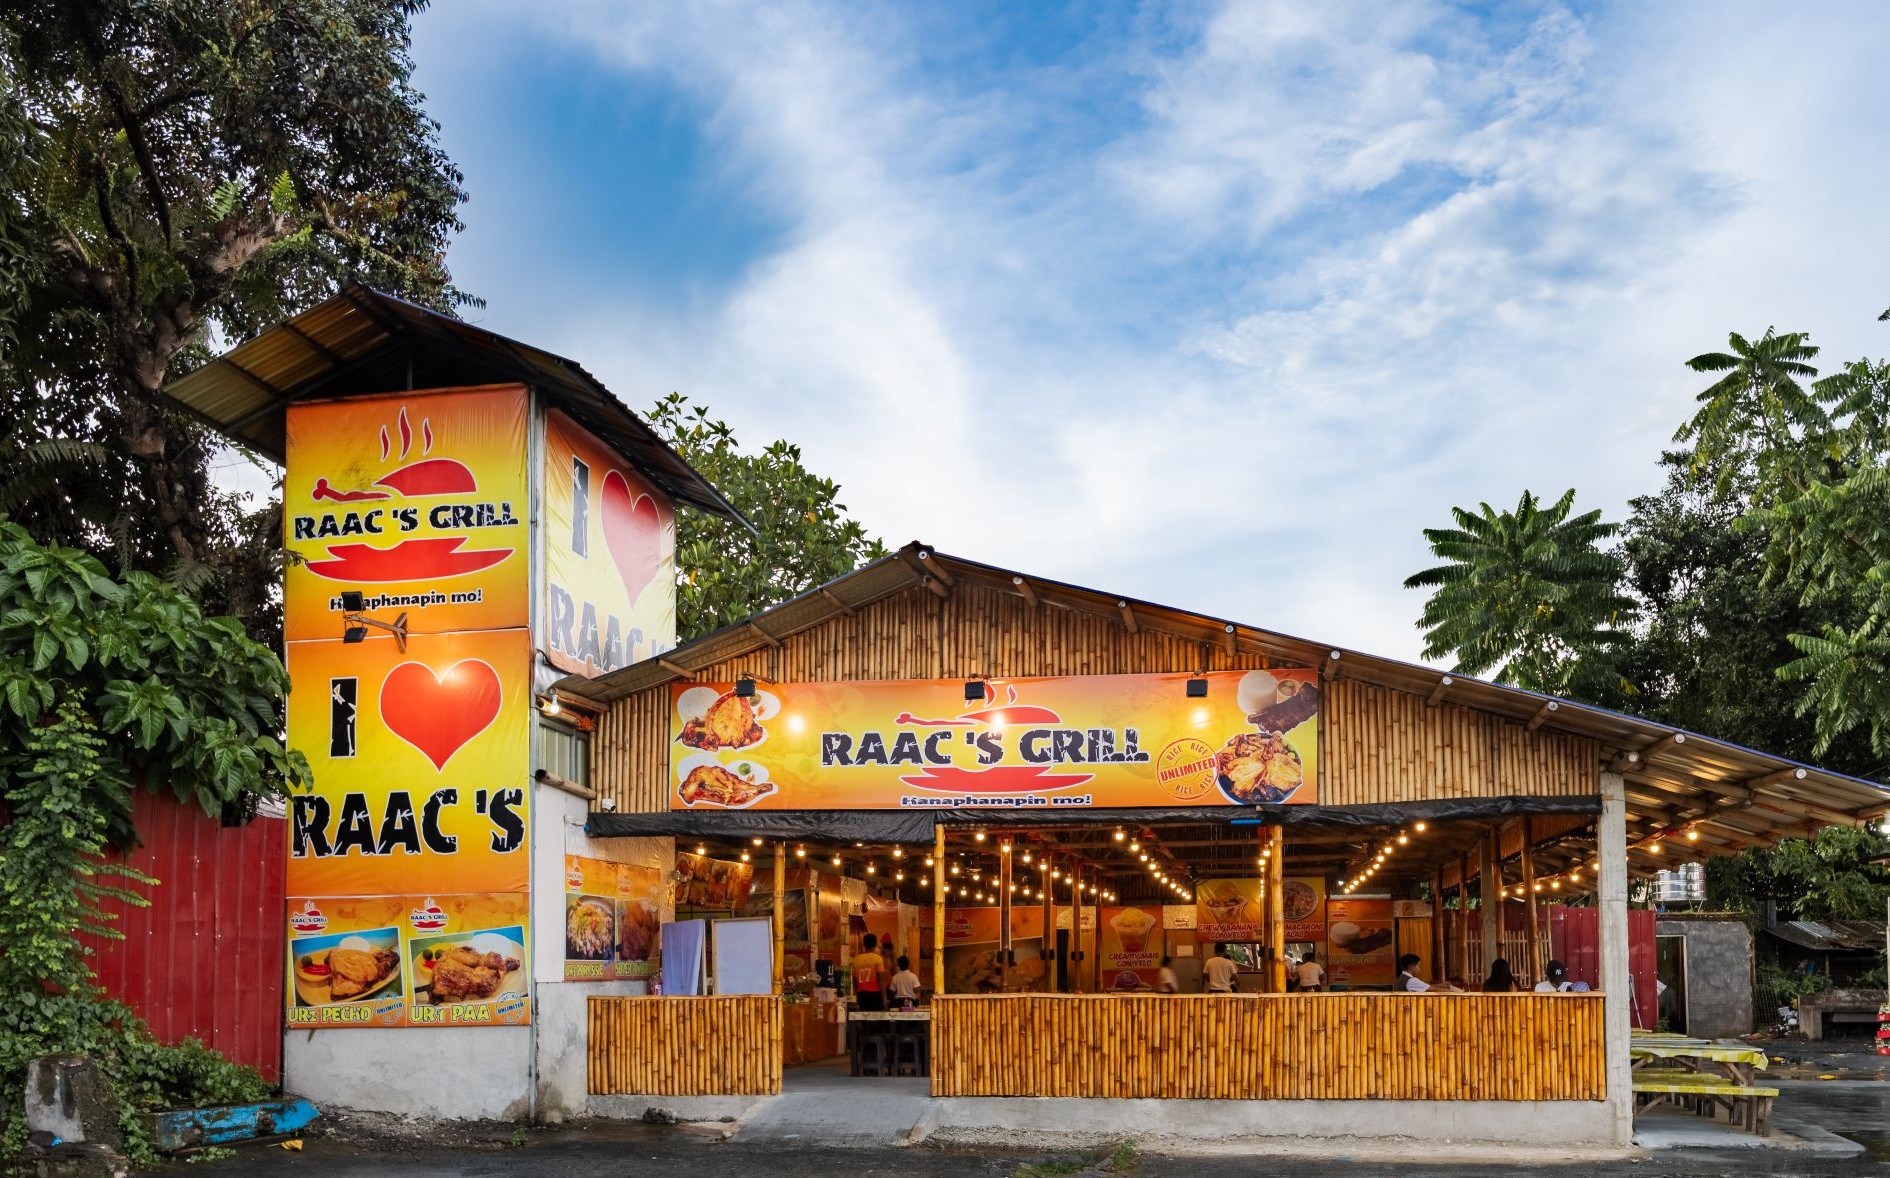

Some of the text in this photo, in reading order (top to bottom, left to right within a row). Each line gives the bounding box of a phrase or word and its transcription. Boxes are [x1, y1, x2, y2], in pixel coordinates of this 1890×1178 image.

[429, 502, 519, 529] GRILL
[572, 456, 590, 559] I
[451, 588, 482, 603] mo!
[330, 677, 358, 757] I
[1018, 728, 1150, 764] GRILL
[1166, 742, 1209, 761] RICE RICE
[1160, 757, 1217, 782] UNLIMITED
[1174, 773, 1214, 795] RICE RICE
[901, 794, 1091, 807] Hanaphanapin mo!
[1285, 922, 1324, 932] MACARONI
[1108, 952, 1160, 961] CREAMY MAIS
[1134, 959, 1152, 967] YELO
[321, 1005, 373, 1023] PECHO
[375, 1002, 404, 1015] UNLIMITED
[451, 1003, 491, 1022] PAA
[496, 1001, 525, 1015] UNLIMITED
